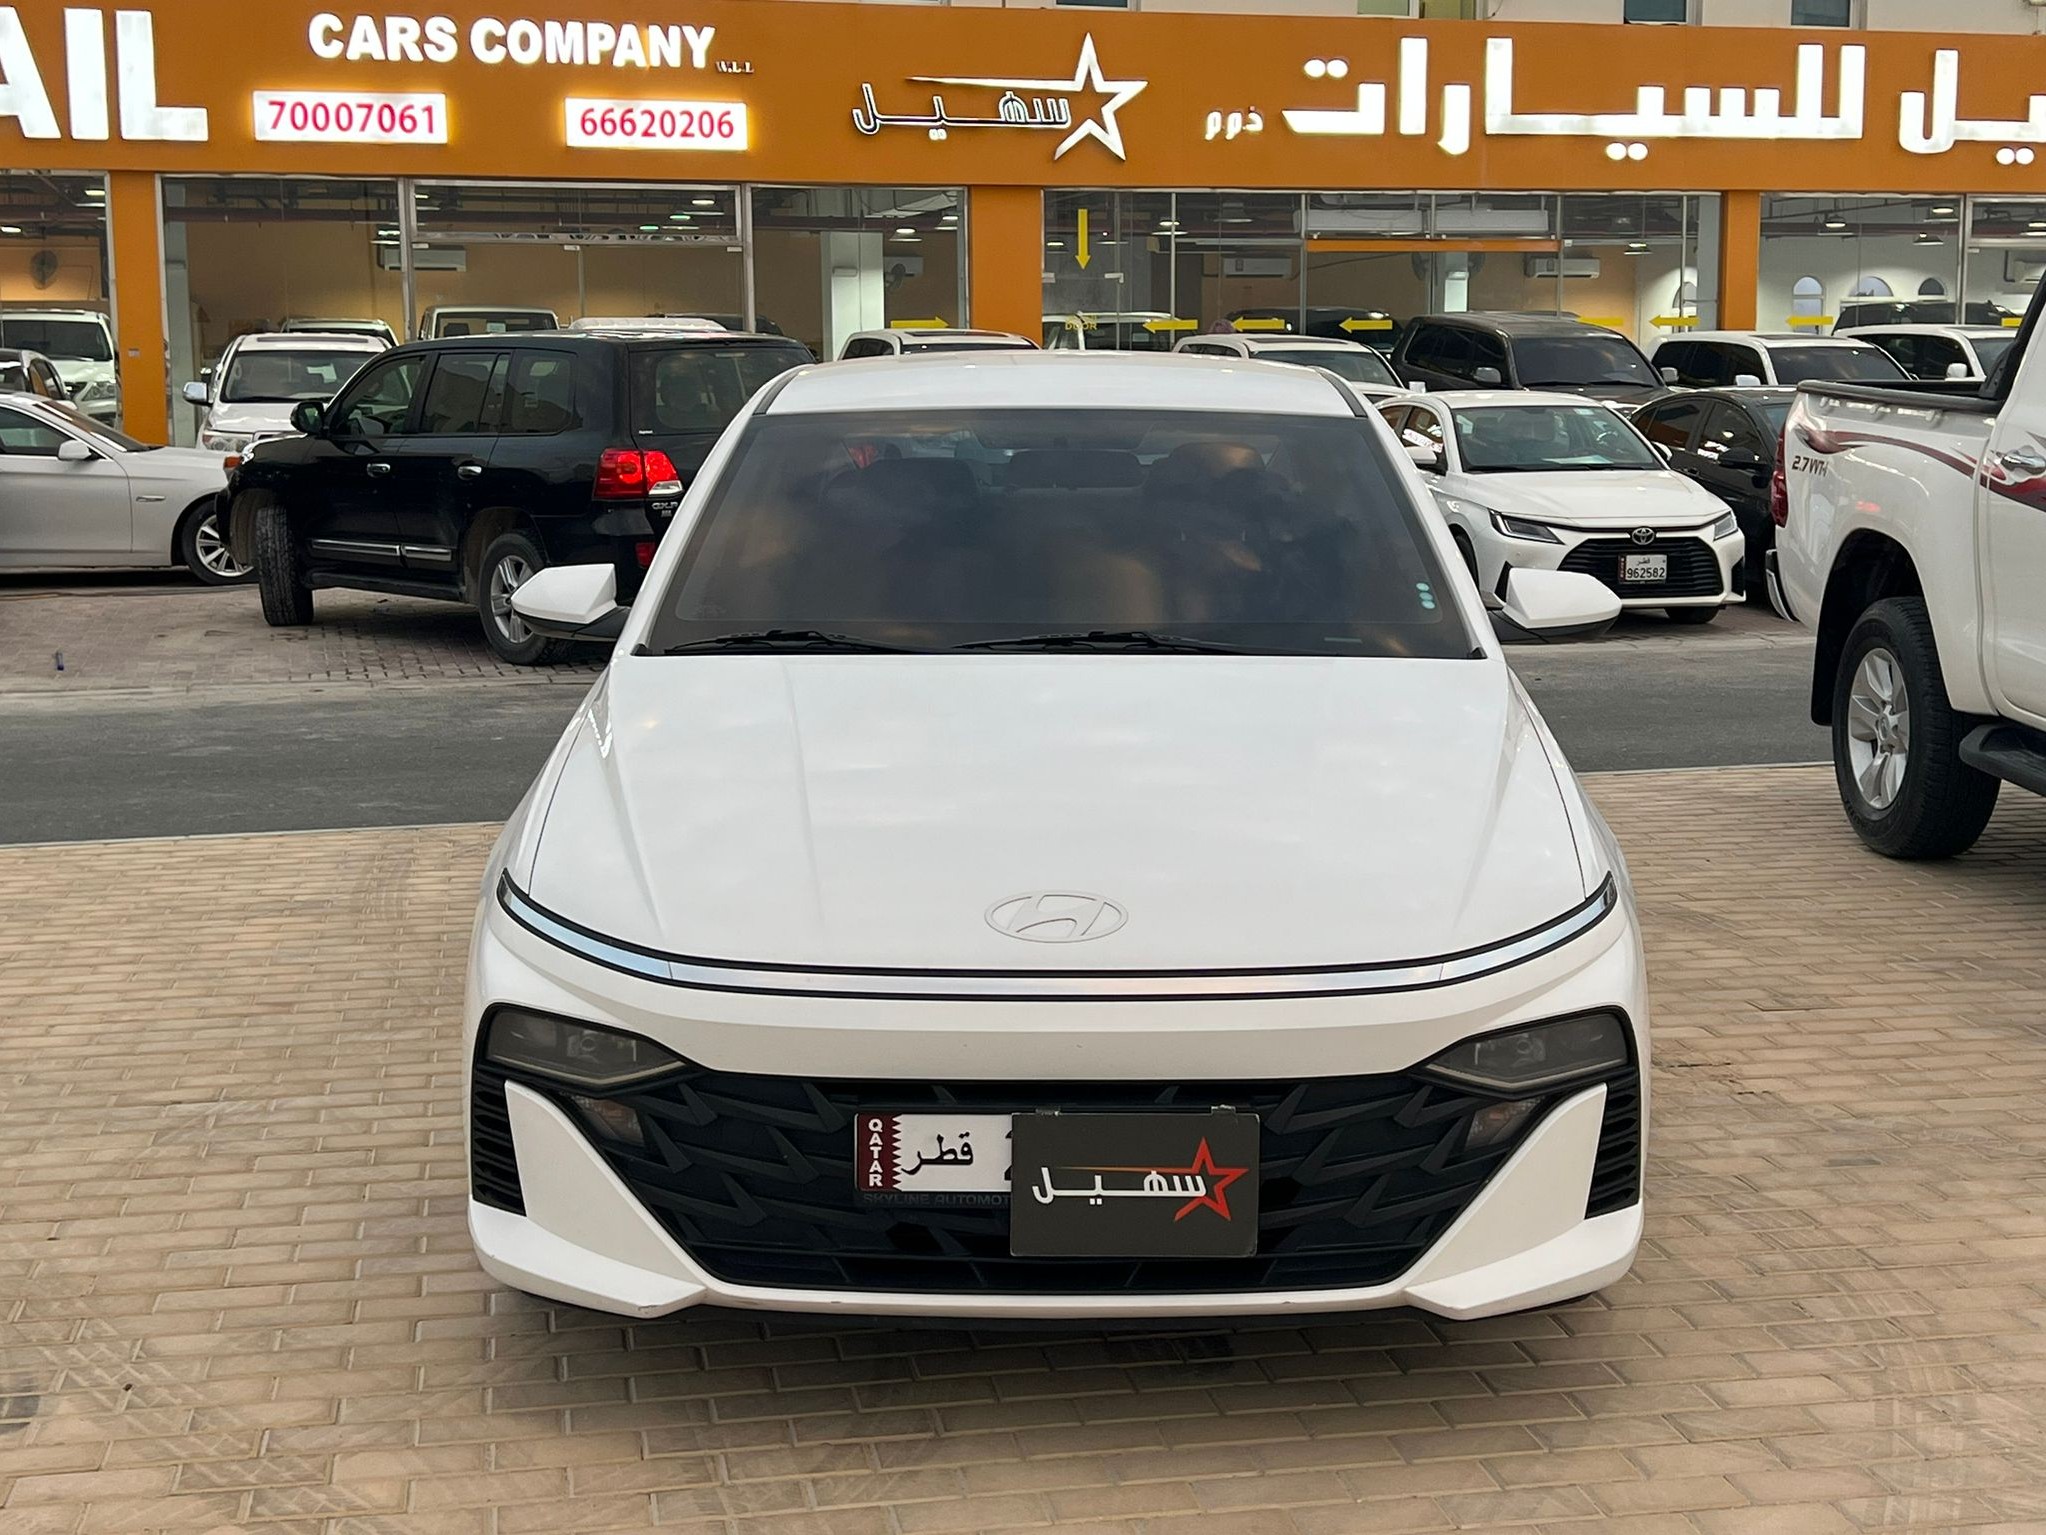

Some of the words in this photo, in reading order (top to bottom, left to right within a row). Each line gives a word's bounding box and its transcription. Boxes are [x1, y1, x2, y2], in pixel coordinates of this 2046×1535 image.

[308, 12, 459, 63] CARS
[470, 17, 716, 69] COMPANY
[268, 100, 434, 134] 70007061
[852, 82, 1072, 140] سهيل
[1281, 36, 1865, 160] للسيارات
[580, 107, 734, 138] 66620206
[1626, 567, 1665, 579] 962582
[868, 1118, 883, 1187] QATAR
[900, 1131, 974, 1176] قطر
[863, 1193, 931, 1204] SKYLINE
[1031, 1166, 1207, 1205] سهيل
